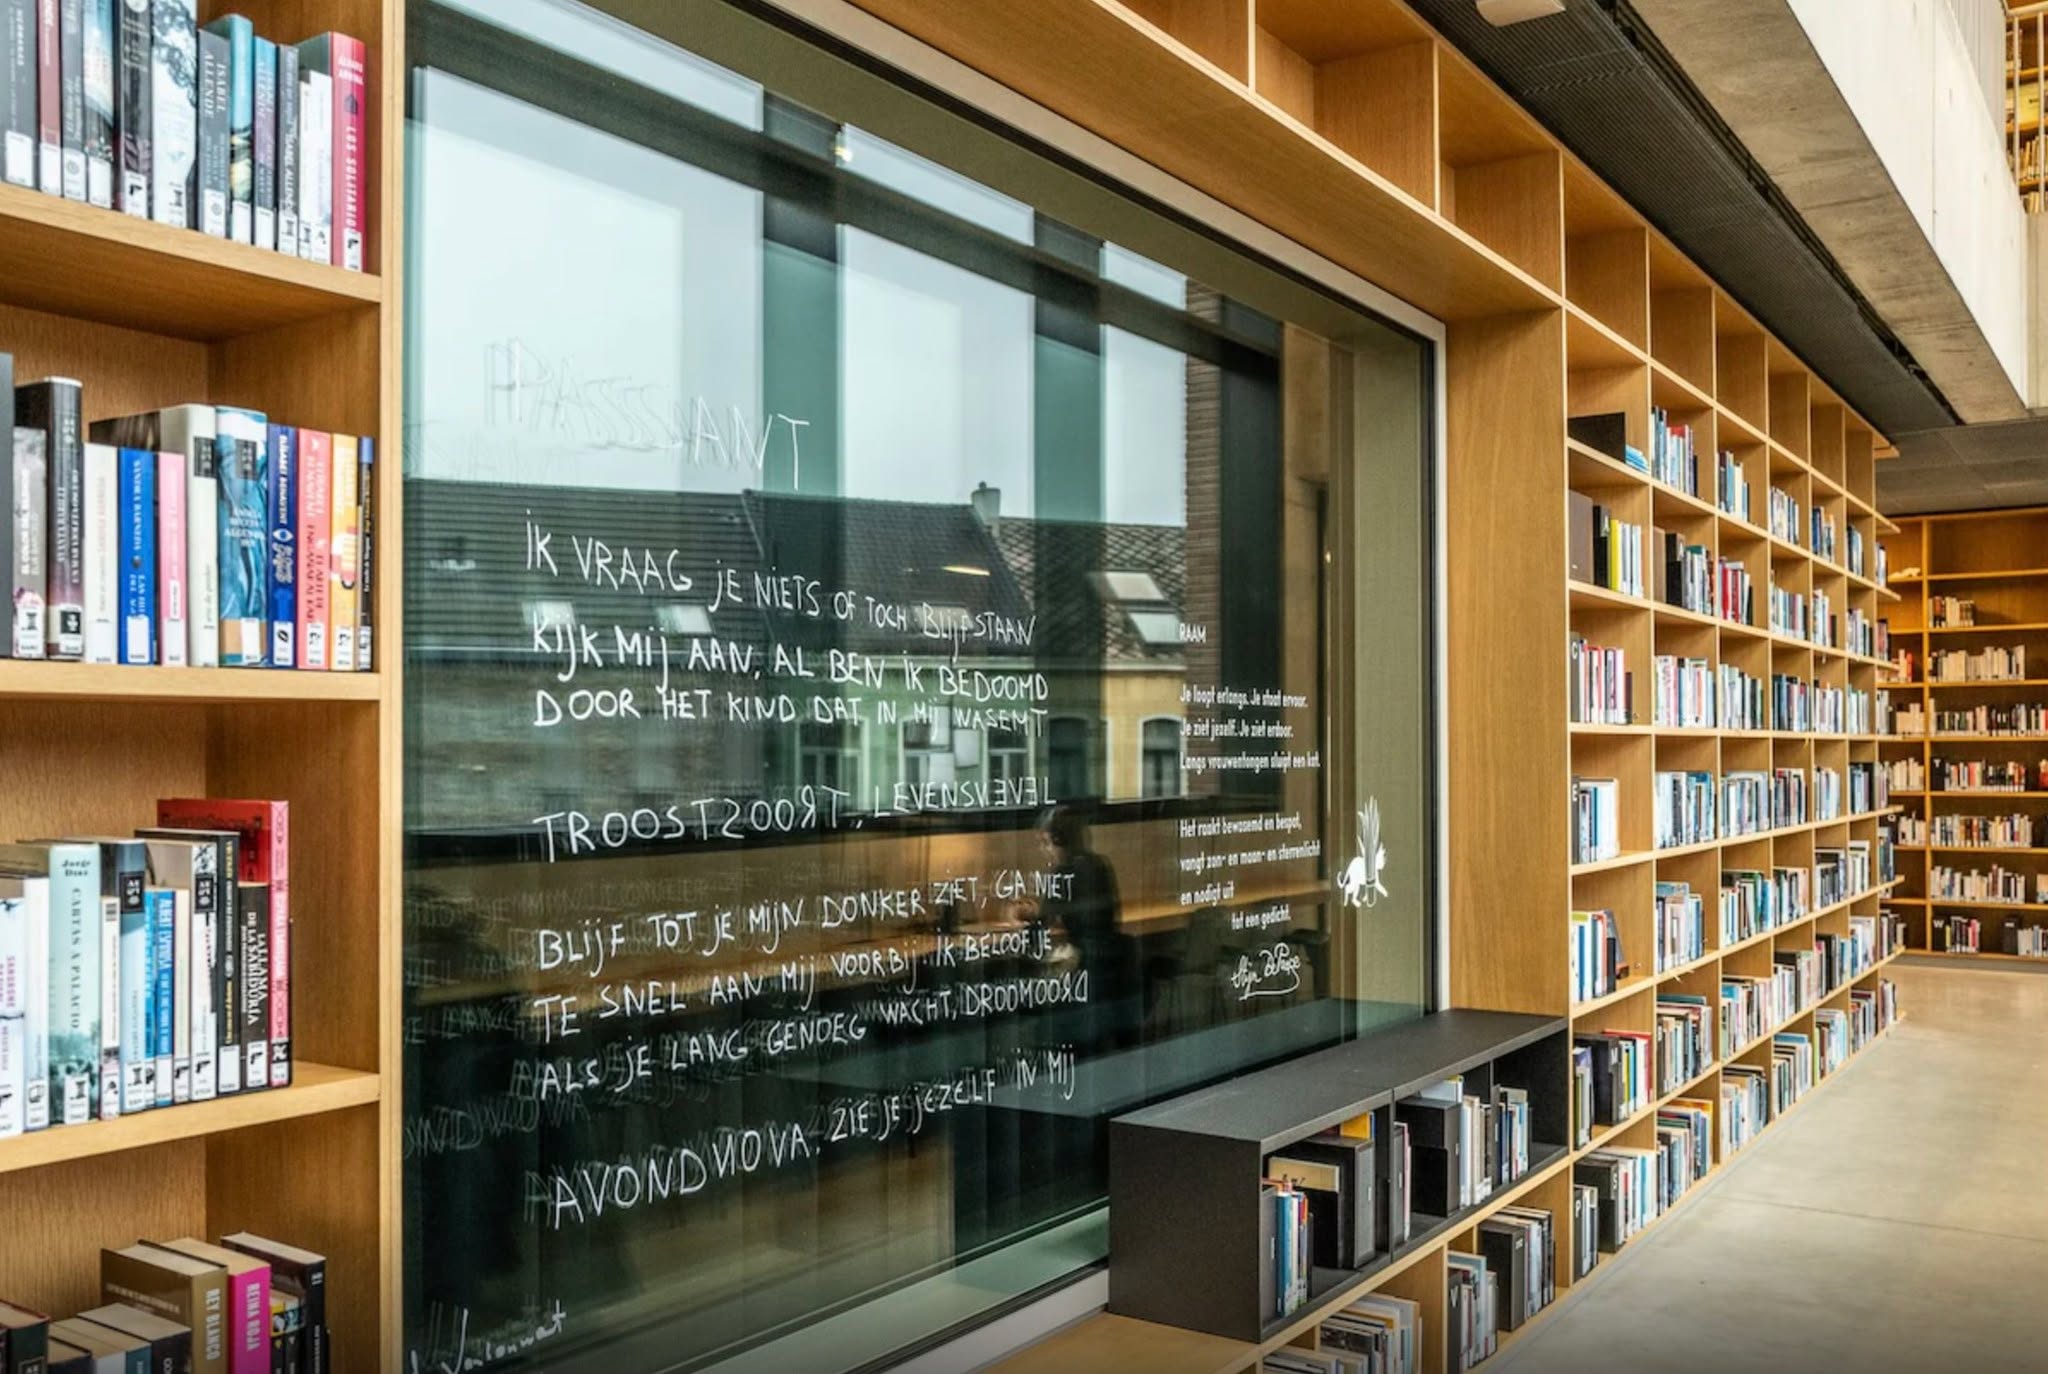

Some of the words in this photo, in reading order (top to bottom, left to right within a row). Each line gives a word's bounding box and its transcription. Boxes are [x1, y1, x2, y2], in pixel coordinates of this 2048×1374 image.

[526, 509, 558, 576] IK
[571, 535, 692, 594] VRAAG
[708, 560, 743, 612] JE
[754, 566, 821, 616] NIETS
[833, 590, 857, 621] OF
[973, 611, 1036, 646] STAAN
[1179, 622, 1207, 643] RAAM
[533, 610, 603, 682] KIJK
[614, 625, 668, 694] MIJ
[688, 638, 761, 680] AAN,
[774, 643, 815, 677] AL
[830, 648, 885, 689] BEN
[902, 650, 924, 693] IK
[939, 665, 1048, 702] BEDOOMD
[534, 688, 641, 727] DOOR
[662, 689, 712, 721] HET
[728, 691, 796, 723] KIND
[814, 695, 862, 726] DAT
[878, 701, 896, 724] IN
[913, 698, 939, 742] MIJ
[954, 707, 1048, 737] WASEMT
[1179, 683, 1192, 702] Je
[1193, 683, 1216, 709] loopt
[1217, 686, 1249, 710] erlangs.
[1250, 688, 1261, 706] Je
[1262, 688, 1282, 707] staat
[1180, 717, 1192, 736] Je
[1193, 717, 1209, 736] ziet
[1238, 719, 1250, 737] Je
[1251, 719, 1266, 737] ziet
[1267, 719, 1294, 738] erdoor.
[1179, 750, 1206, 775] Langs
[1208, 751, 1269, 774] vrouwentongen
[1270, 751, 1291, 774] sluipt
[1292, 755, 1306, 769] een
[1180, 817, 1196, 838] Het
[1197, 817, 1220, 837] raakt
[1221, 813, 1263, 835] bewasemd
[1264, 818, 1275, 831] en
[1180, 851, 1205, 876] vangt
[1228, 853, 1239, 866] en
[1267, 849, 1278, 862] en
[1278, 839, 1320, 860] sterrenlicht
[1181, 891, 1192, 906] en
[1193, 882, 1221, 907] nodigt
[1222, 880, 1234, 899] uit
[71, 888, 81, 946] CARTAS
[247, 912, 256, 927] DE
[539, 917, 625, 978] BLIJF
[647, 911, 697, 948] TOT
[702, 904, 735, 956] JE
[749, 898, 804, 954] MIJN
[821, 888, 926, 928] DONKER
[995, 869, 1026, 898] GA
[1035, 862, 1075, 901] NIET
[1231, 910, 1244, 929] tot
[1245, 913, 1260, 928] een
[247, 945, 261, 1025] SABIDURÍA
[257, 949, 269, 1000] LLAMA
[534, 995, 580, 1043] TE
[600, 981, 687, 1018] SNEL
[710, 972, 763, 1006] AAN
[781, 955, 816, 1012] MIJ
[936, 927, 956, 968] IK
[964, 930, 1029, 962] BELOOF
[1035, 920, 1053, 960] JE
[71, 966, 81, 1029] PALACIO
[541, 1059, 600, 1100] ALS
[614, 1036, 652, 1093] JE
[671, 1030, 748, 1070] LANG
[767, 1013, 867, 1056] GENOEG
[831, 1098, 869, 1142] ZIE
[878, 1096, 900, 1142] JE
[913, 1069, 996, 1135] JEZELF
[1016, 1048, 1037, 1091] IN
[1049, 1044, 1076, 1101] MIJ
[206, 1287, 221, 1311] REY
[246, 1282, 261, 1319] REINA
[206, 1313, 221, 1361] BLANCO
[246, 1320, 261, 1352] ROJA
